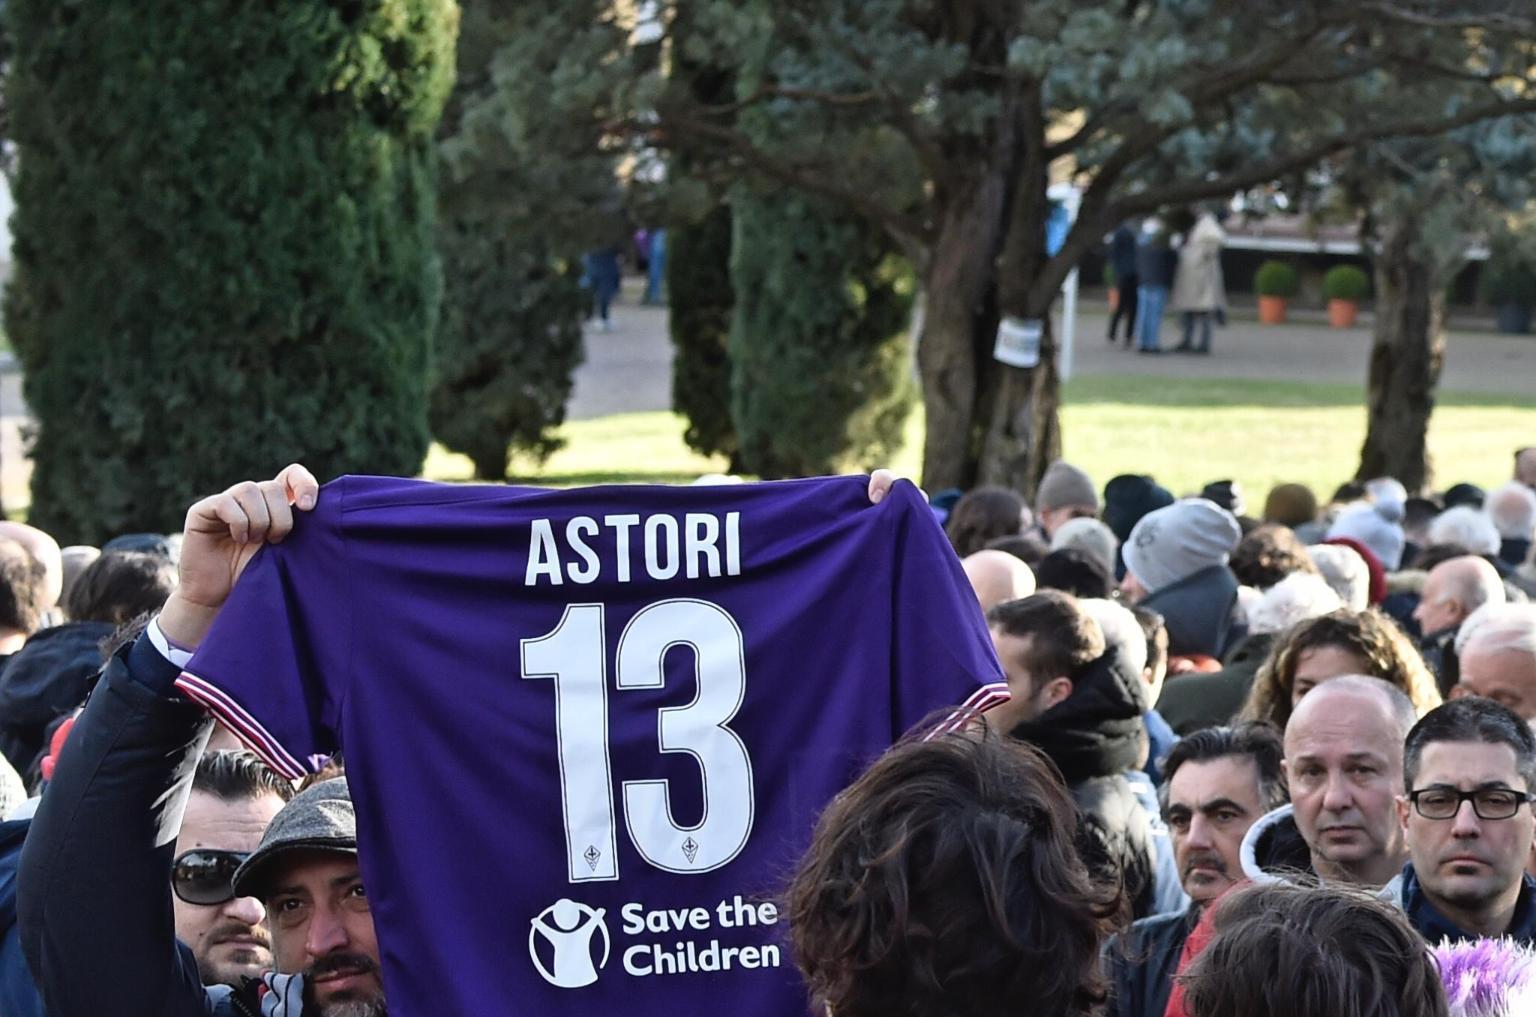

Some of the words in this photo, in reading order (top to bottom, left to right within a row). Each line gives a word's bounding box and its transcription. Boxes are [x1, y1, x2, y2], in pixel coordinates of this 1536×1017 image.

[524, 512, 741, 586] ASTORI
[520, 597, 755, 883] 13
[621, 903, 710, 935] Save
[716, 895, 778, 927] the
[622, 940, 780, 976] Children
